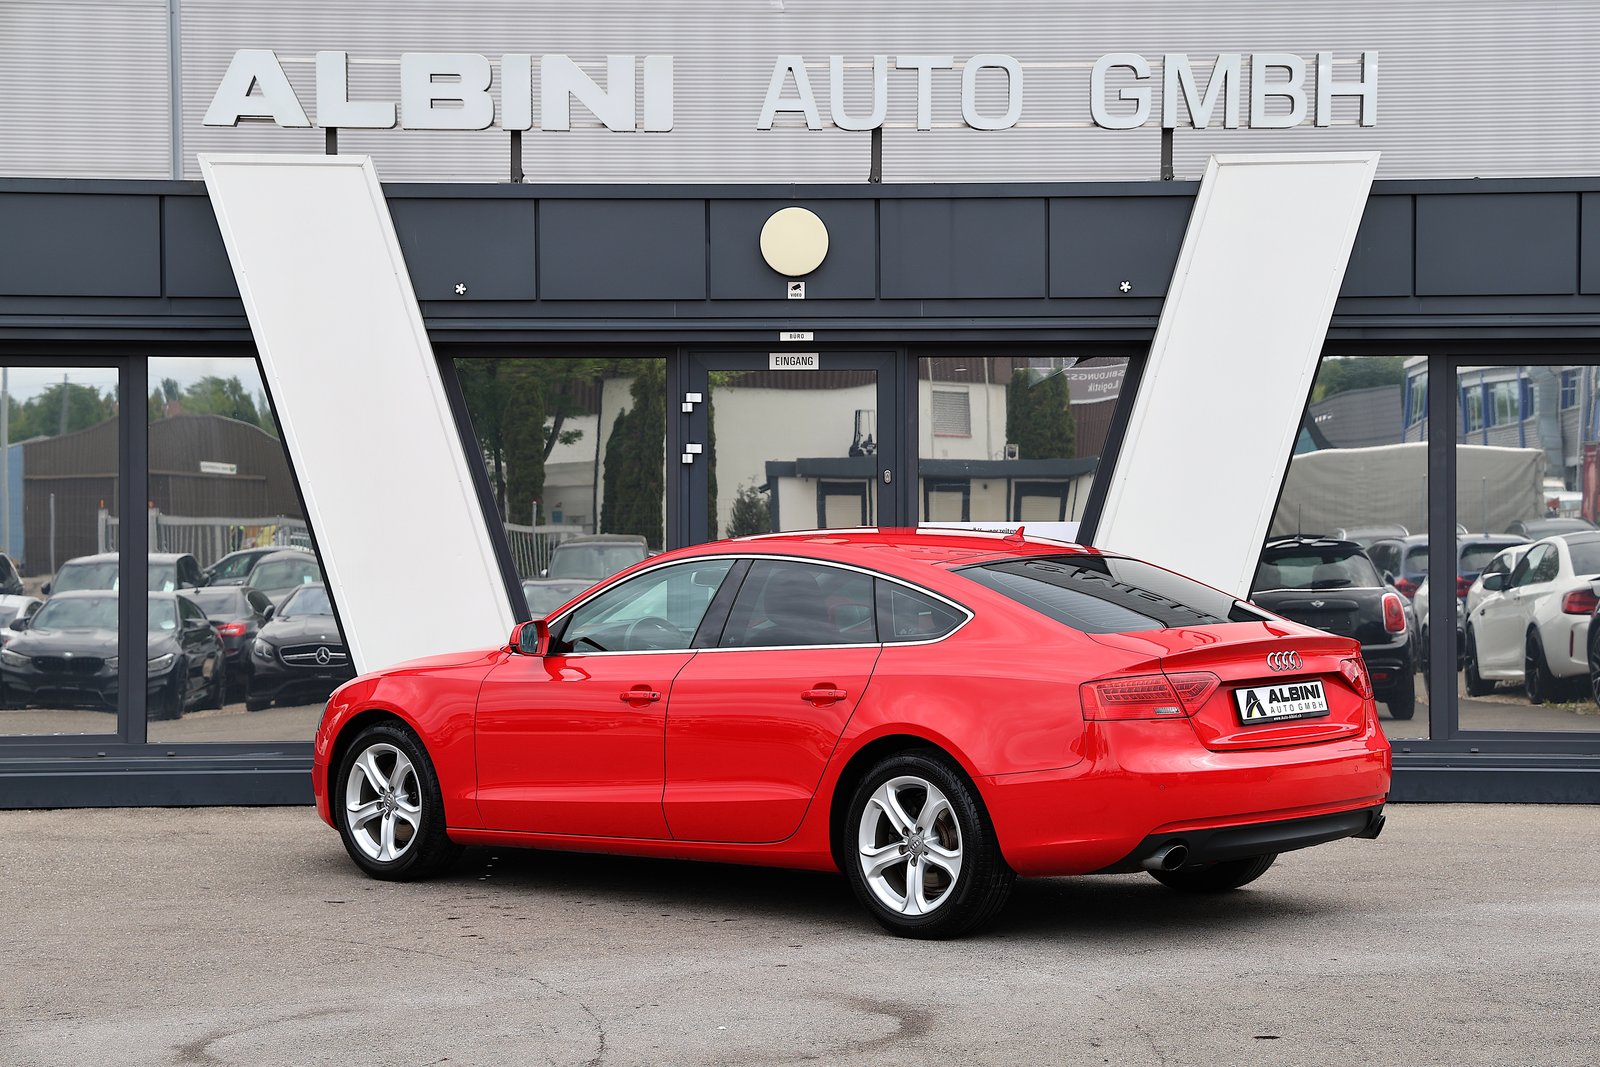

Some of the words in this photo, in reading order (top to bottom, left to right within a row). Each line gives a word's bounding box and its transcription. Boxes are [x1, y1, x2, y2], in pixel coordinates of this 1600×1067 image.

[202, 49, 674, 132] ALBINI
[756, 53, 1024, 132] AUTO
[1089, 51, 1380, 130] GMBH
[775, 356, 814, 366] EINGANG
[1269, 684, 1321, 704] ALBINI
[1270, 703, 1295, 714] AUTO
[1298, 701, 1324, 711] GMBH
